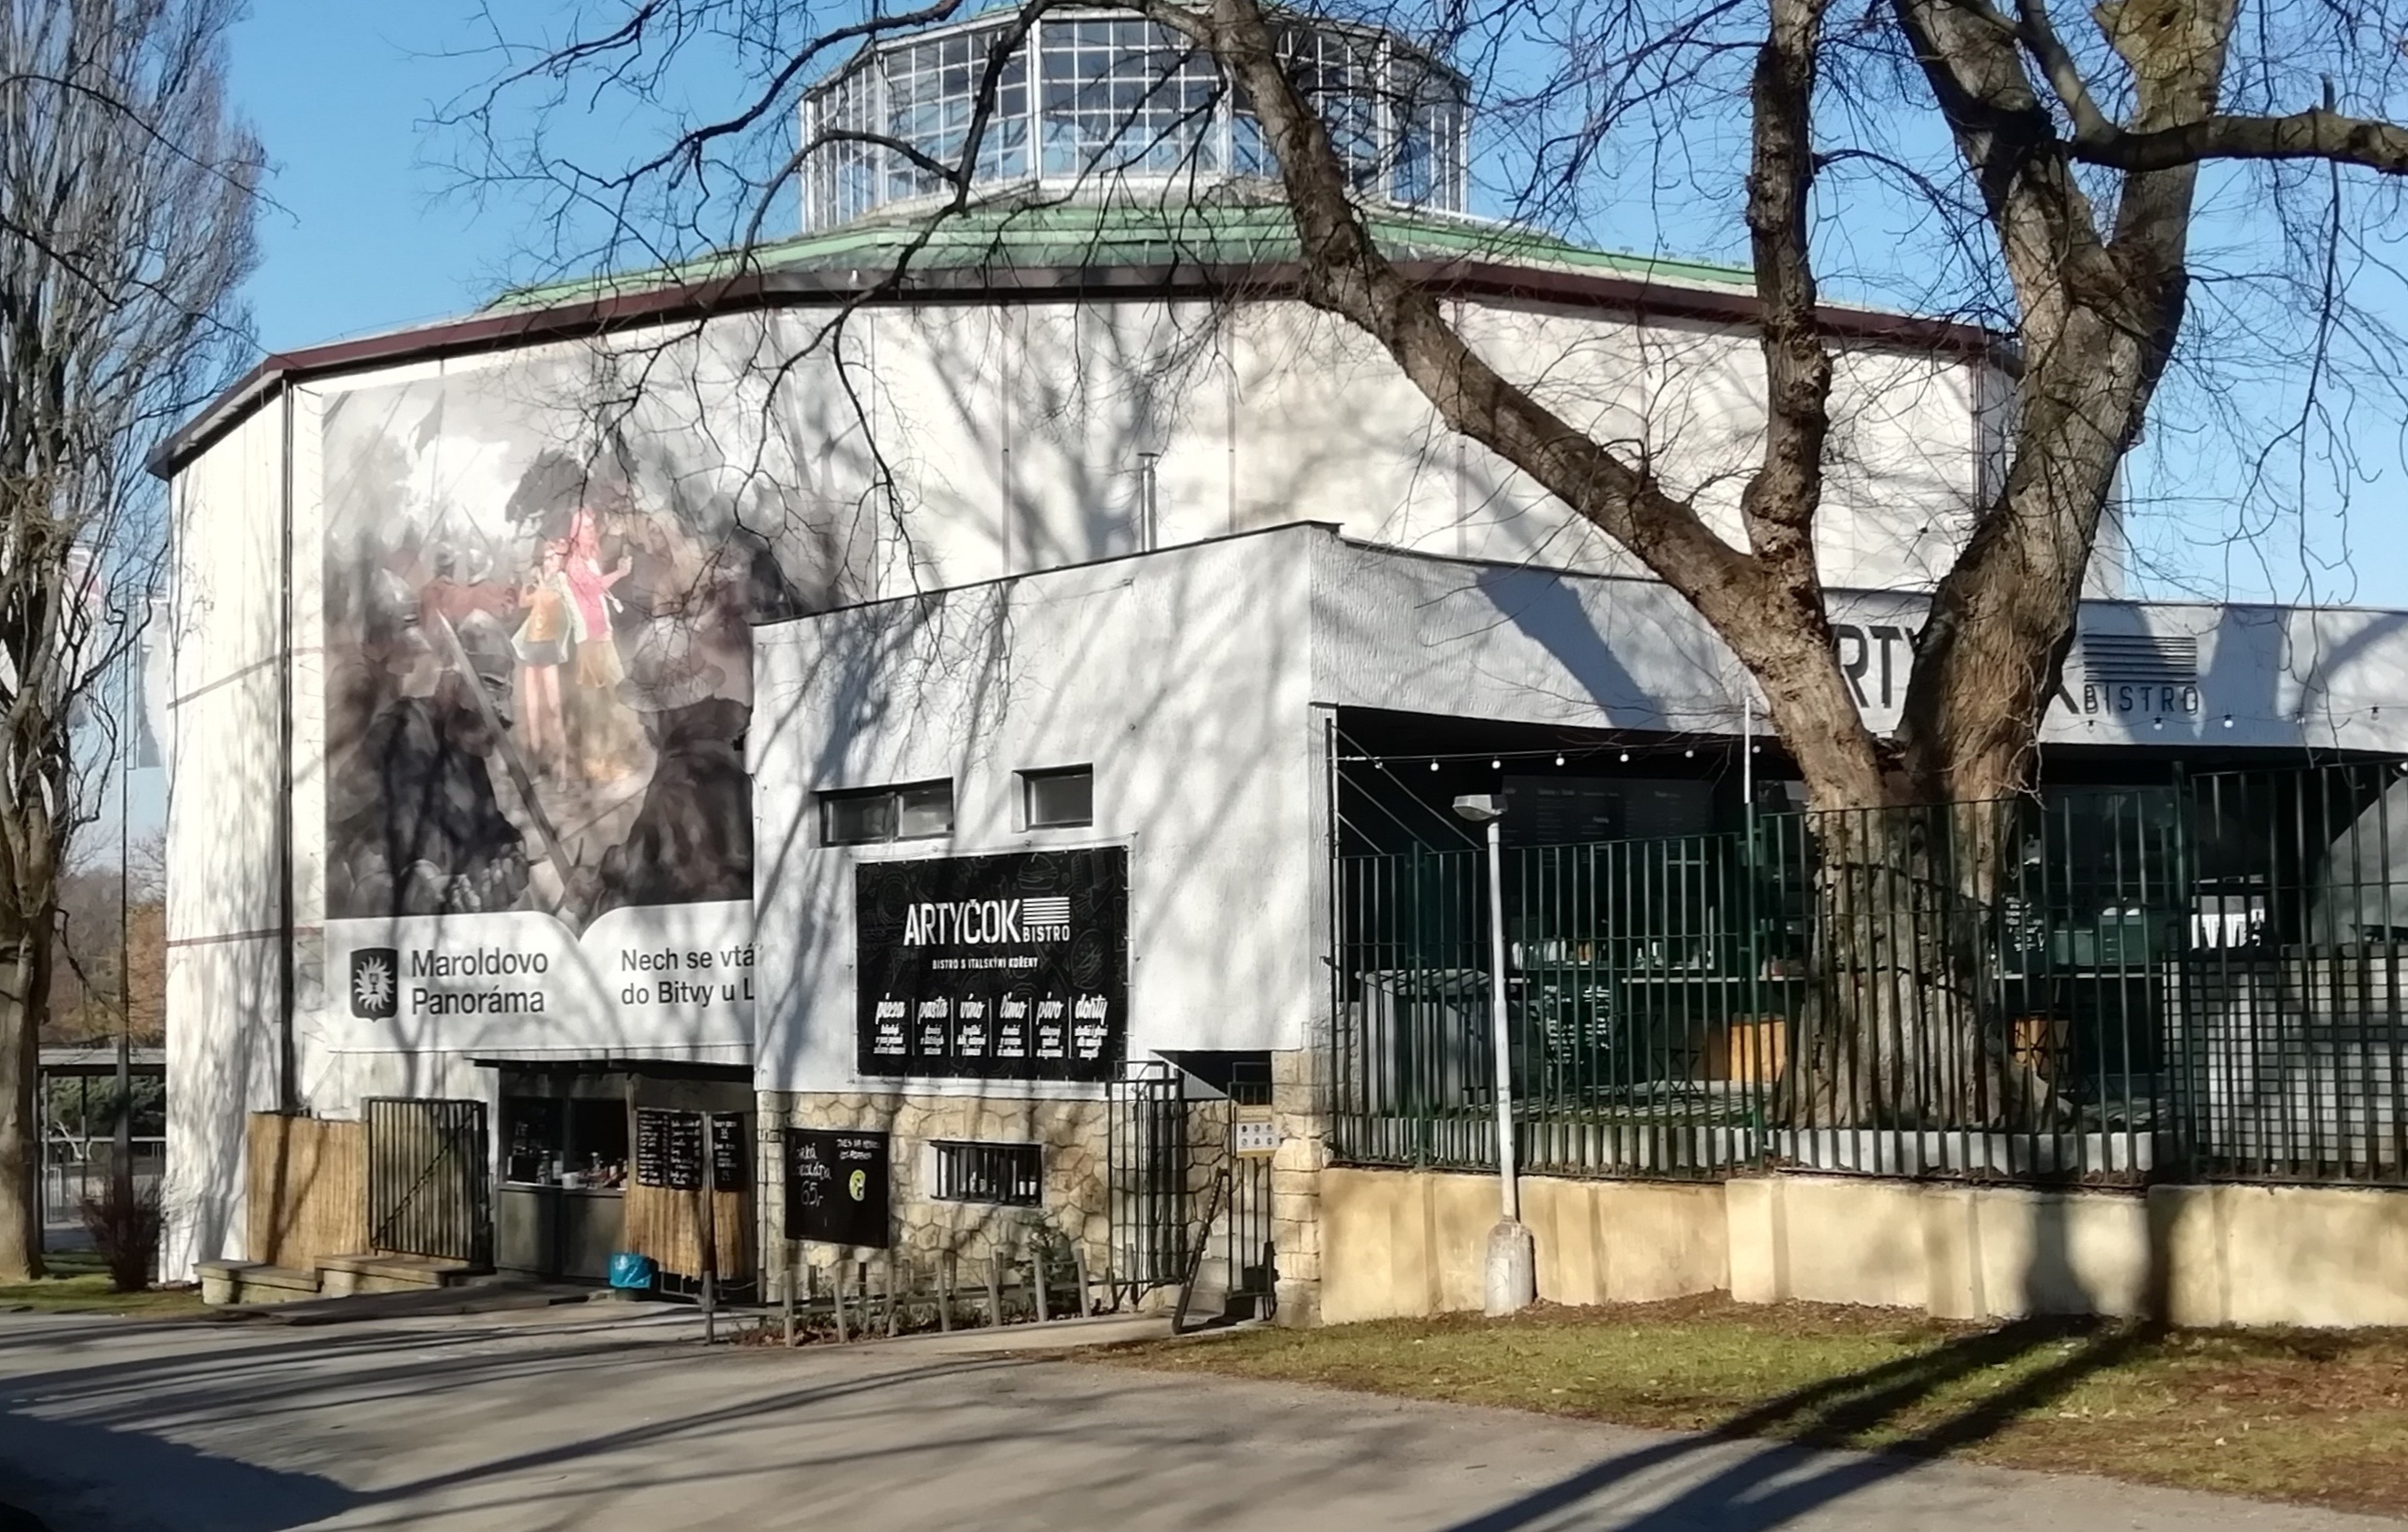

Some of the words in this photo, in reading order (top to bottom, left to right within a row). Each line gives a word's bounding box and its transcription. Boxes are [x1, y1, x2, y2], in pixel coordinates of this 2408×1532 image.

[2084, 684, 2198, 715] BISTRO
[904, 899, 1021, 946] ARTYČOK
[1022, 924, 1070, 943] BISTRO
[412, 948, 548, 977] Maroldovo
[621, 949, 677, 971] Nech
[685, 950, 712, 970] se
[932, 957, 959, 970] BISTRO
[961, 957, 967, 969] S
[412, 985, 544, 1015] Panoráma
[621, 983, 649, 1005] do
[658, 981, 713, 1007] Bitvy
[722, 983, 735, 1001] u
[1036, 991, 1064, 1025] pivo
[917, 996, 948, 1024] pasta
